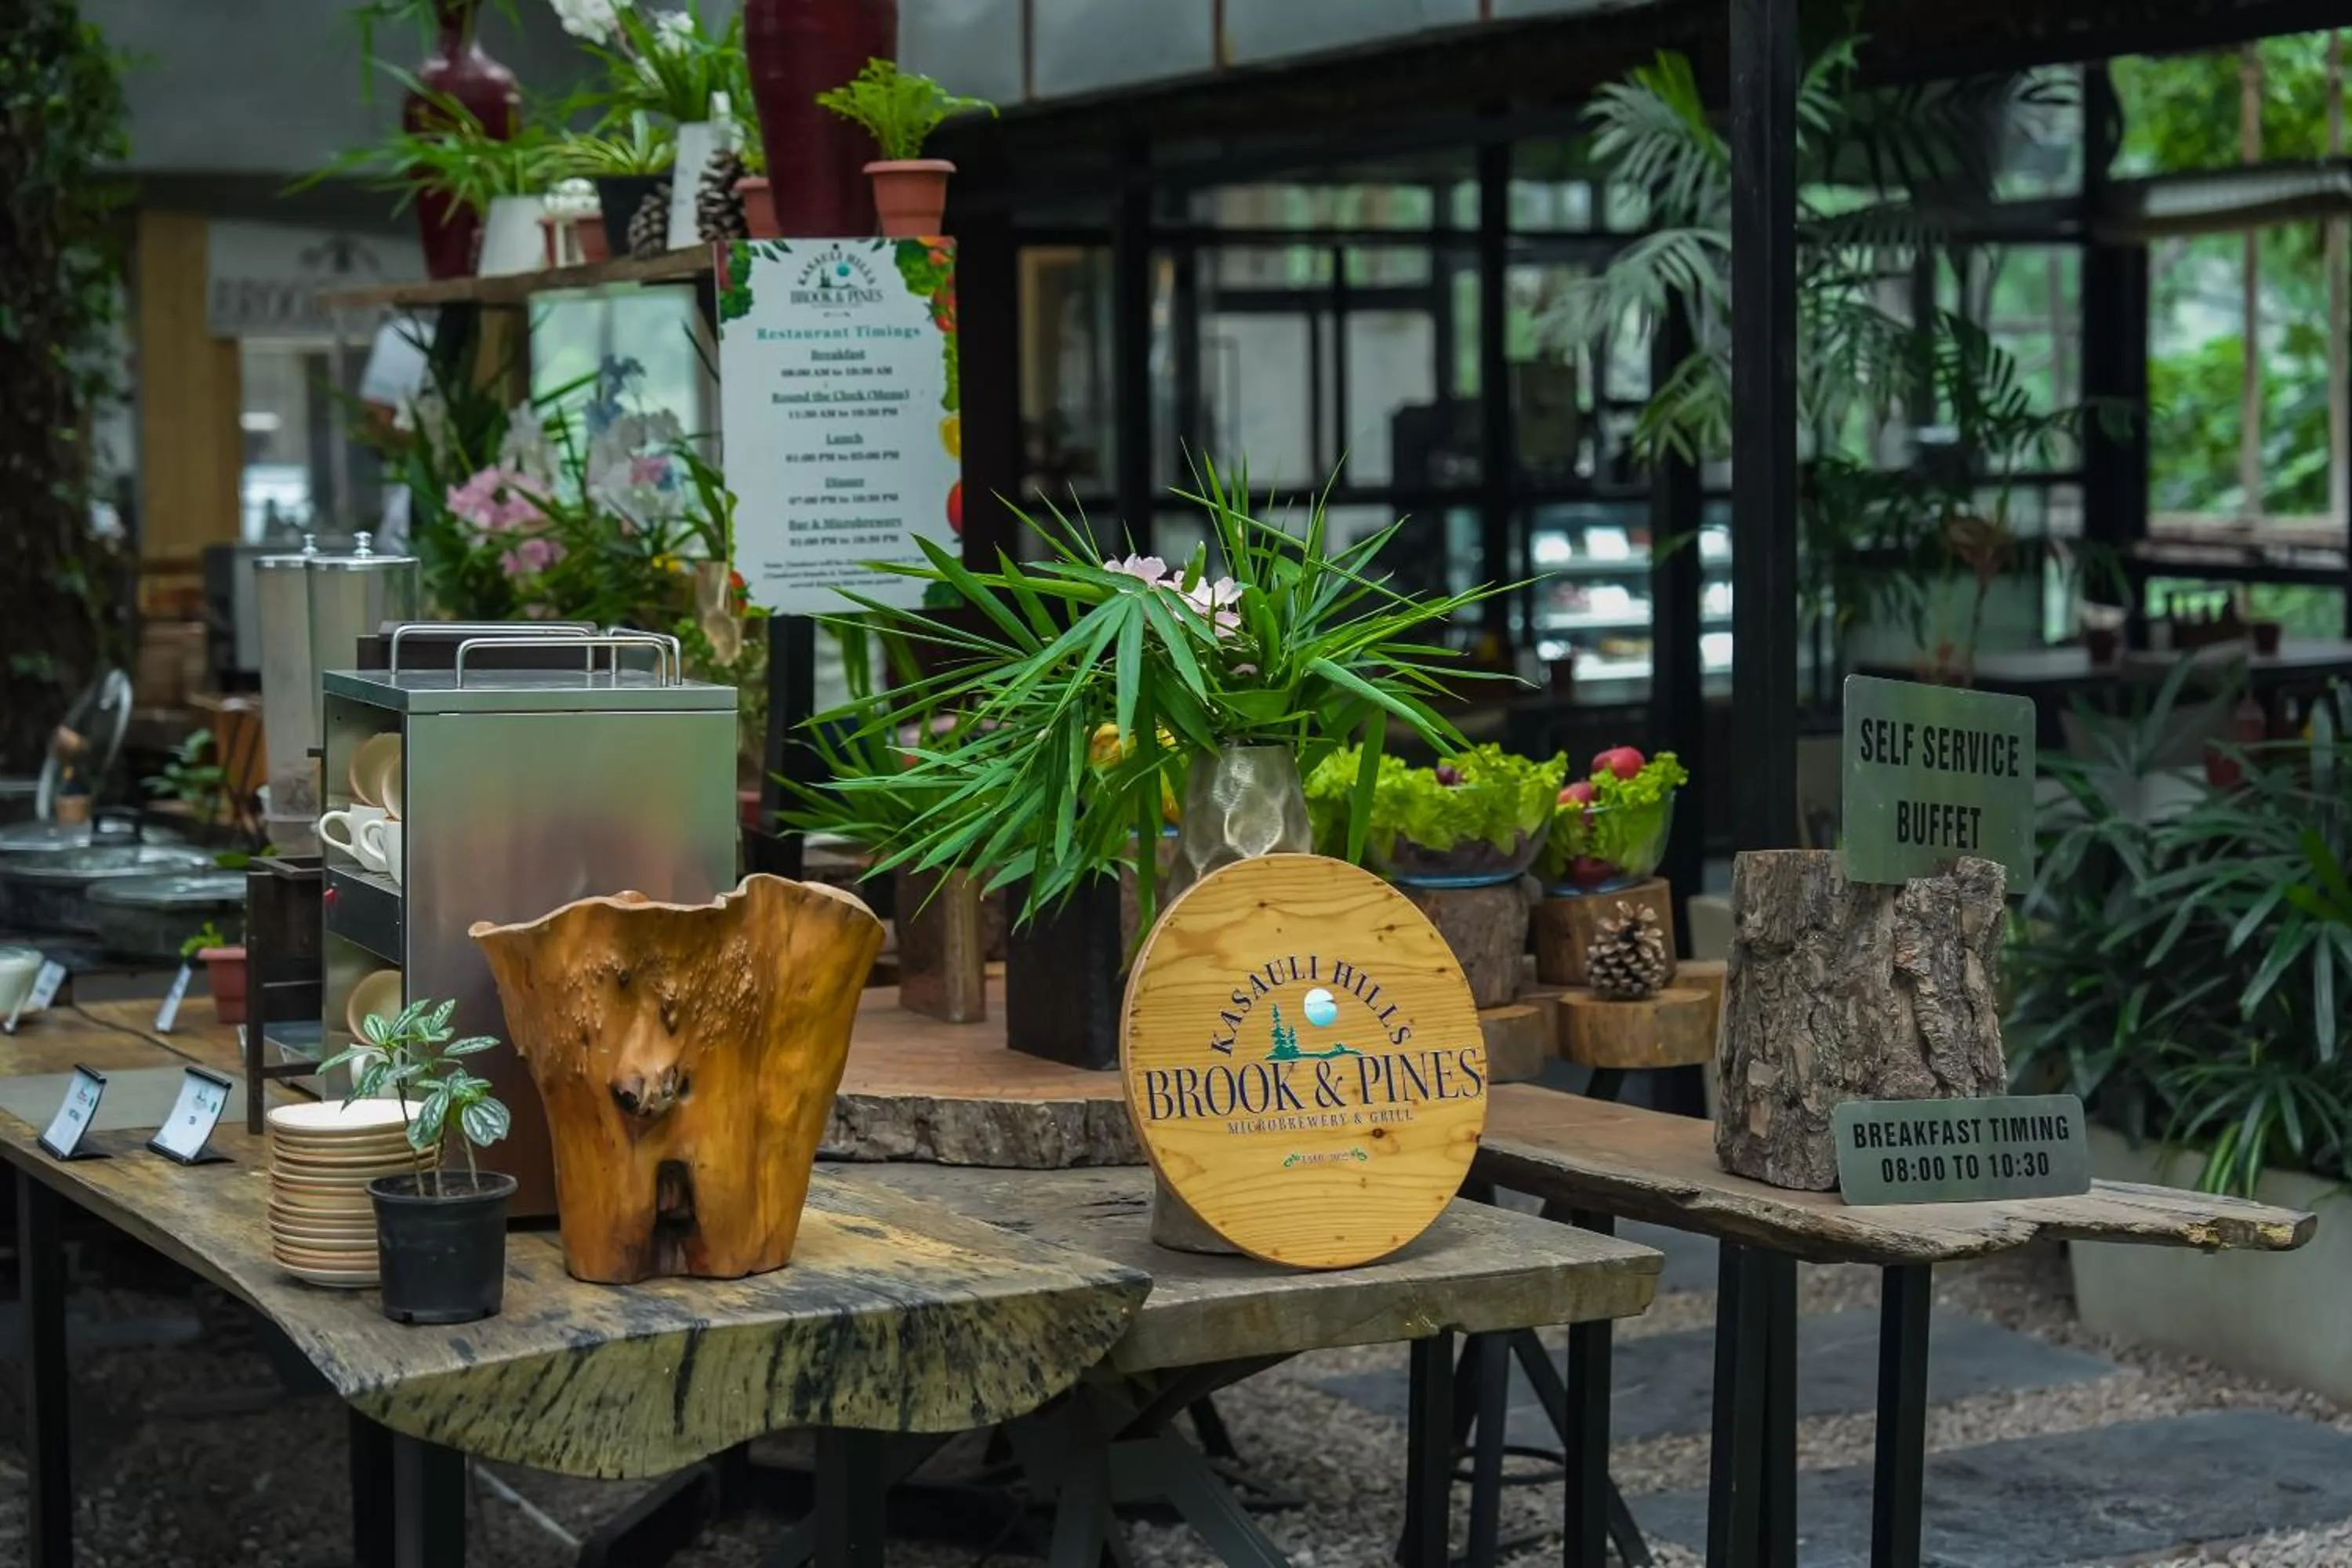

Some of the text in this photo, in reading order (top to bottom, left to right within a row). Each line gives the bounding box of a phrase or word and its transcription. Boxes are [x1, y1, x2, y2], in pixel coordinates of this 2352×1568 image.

[757, 325, 921, 340] Restaurant Timings
[826, 432, 864, 445] Lunch
[1860, 718, 2019, 777] SELF SERVICE
[1896, 800, 1981, 849] BUFFET
[1210, 955, 1412, 1058] KASAULI HILLS
[1145, 1047, 1483, 1121] BROOK & PINES
[1228, 1108, 1414, 1134] MICROBREWERY & GRILL
[1853, 1115, 2070, 1149] BREAKFAST TIMING
[1882, 1152, 2049, 1184] 08:00 TO 10:30
